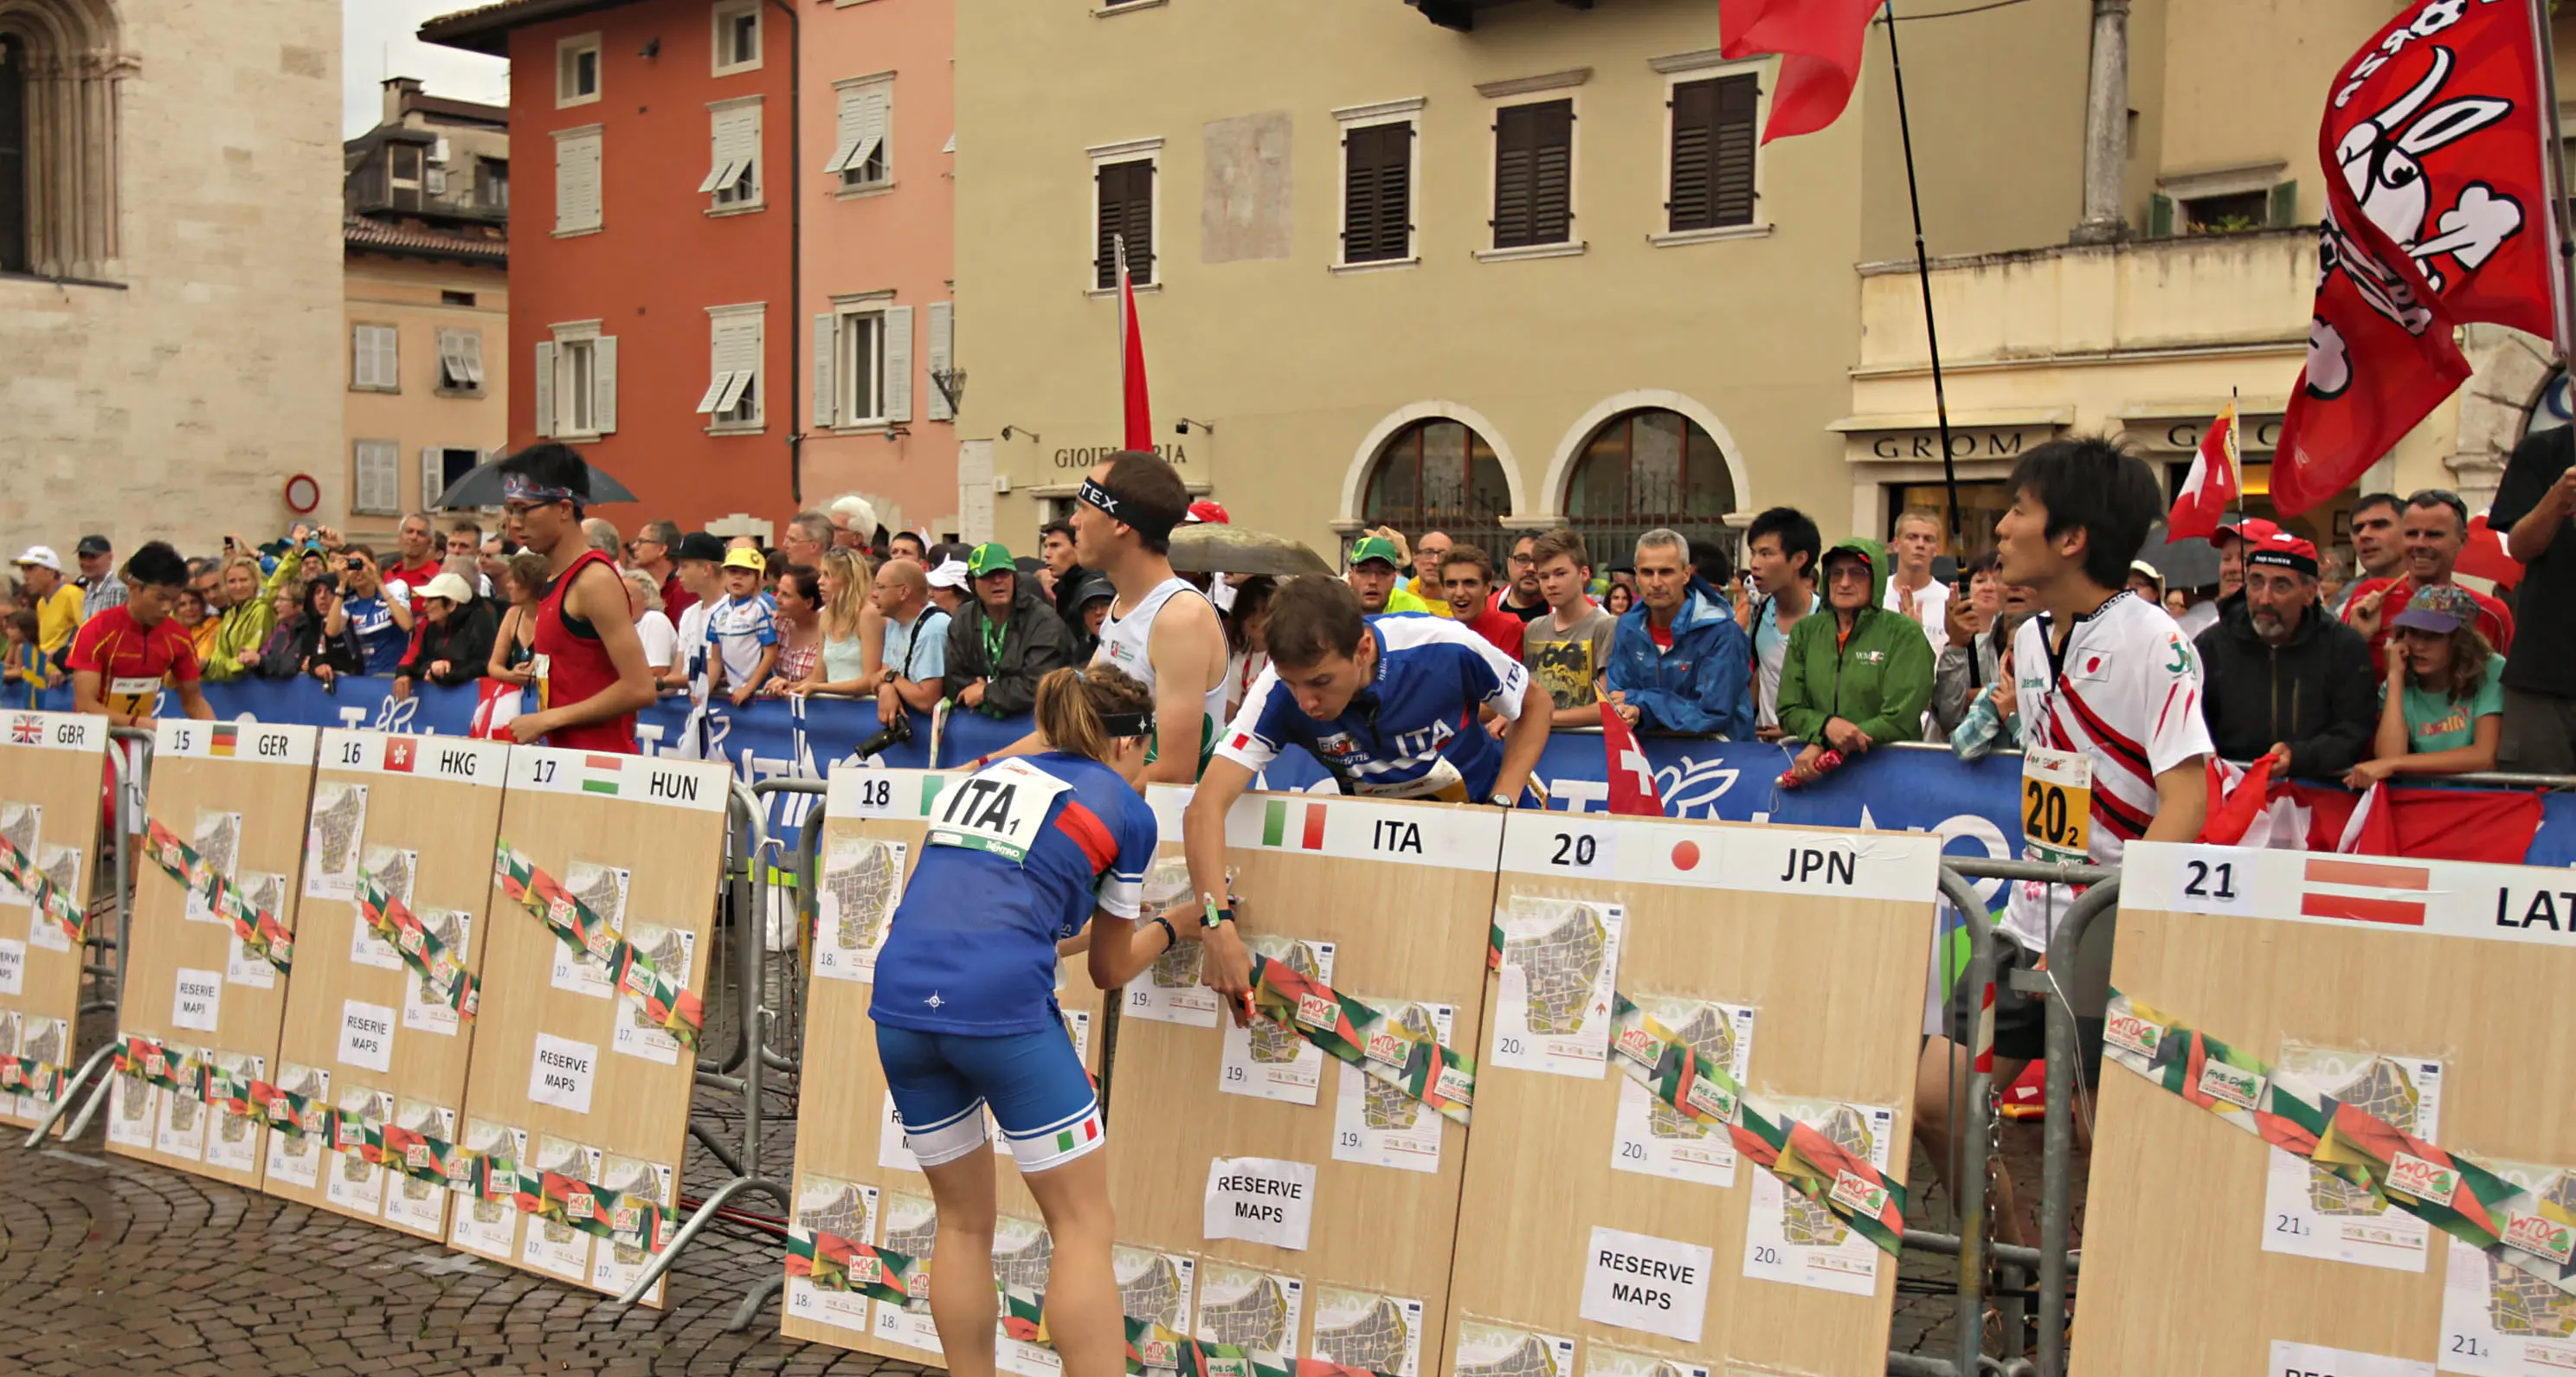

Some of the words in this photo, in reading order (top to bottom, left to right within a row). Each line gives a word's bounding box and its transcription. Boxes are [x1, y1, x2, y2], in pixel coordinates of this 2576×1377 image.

[1873, 433, 2022, 459] GROM
[1506, 662, 1521, 691] ITA
[126, 694, 141, 715] 7
[57, 724, 85, 745] GBR
[174, 730, 190, 750] 15
[258, 734, 288, 757] GER
[1395, 718, 1455, 759] ITA
[341, 742, 362, 764] 16
[441, 749, 478, 776] HKG
[532, 759, 557, 783] 17
[649, 771, 699, 801] HUN
[862, 780, 890, 807] 18
[1373, 820, 1422, 854] ITA
[1550, 833, 1596, 865] 20
[1781, 848, 1857, 885] JPN
[2184, 860, 2236, 898] 21
[2496, 886, 2576, 932] LAT
[179, 983, 215, 998] RESERVE
[184, 1001, 206, 1015] MAPS
[347, 1015, 387, 1036] RESERVE
[2109, 1012, 2154, 1039] WTOC
[351, 1037, 379, 1053] MAPS
[539, 1050, 589, 1074] RESERVE
[545, 1073, 576, 1092] MAPS
[2394, 1155, 2448, 1185] WOC
[1217, 1175, 1303, 1200] RESERVE
[1839, 1172, 1879, 1200] WOC
[1235, 1201, 1284, 1224] MAPS
[2508, 1211, 2566, 1244] WTOC
[1599, 1249, 1695, 1286] RESERVE
[1612, 1283, 1672, 1311] MAPS
